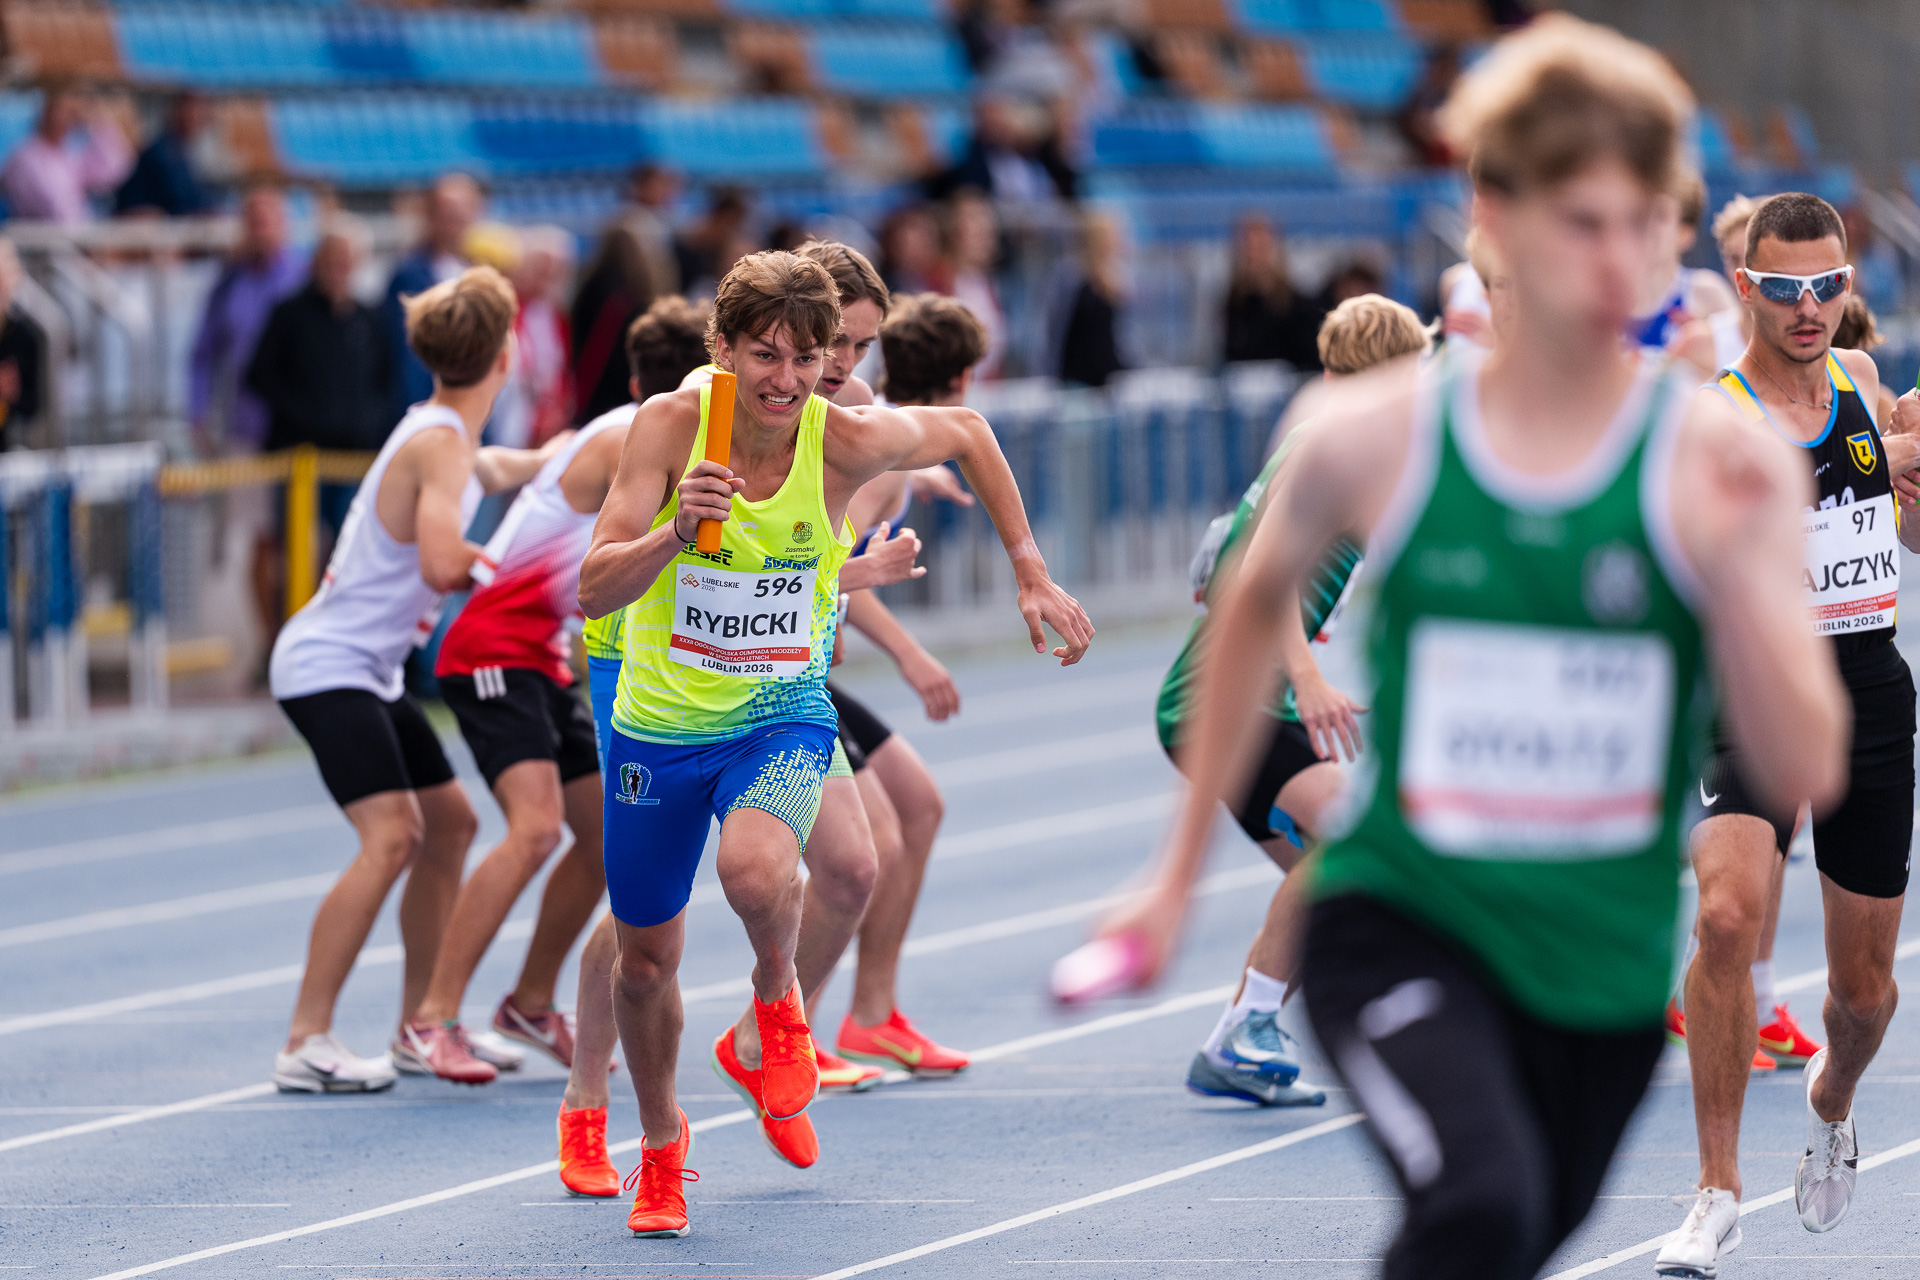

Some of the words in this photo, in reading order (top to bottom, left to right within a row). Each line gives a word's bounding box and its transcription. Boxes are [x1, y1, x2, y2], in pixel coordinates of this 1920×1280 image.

[1852, 506, 1876, 535] 97
[1801, 549, 1897, 592] AJCZYK
[701, 584, 716, 592] 2026
[702, 577, 740, 589] LUBELSKIE
[754, 576, 802, 598] 596
[686, 605, 798, 638] RYBICKI
[1820, 609, 1854, 619] SPORTACH
[1854, 605, 1879, 614] LETNICH
[1813, 620, 1851, 632] UBLIN
[1854, 614, 1884, 627] 2026
[679, 637, 694, 645] XXXII
[694, 640, 738, 657] OGÓLNOPOLSKA
[739, 649, 770, 657] OLIMPIADA
[770, 647, 802, 655] MŁODZIEŻY
[701, 658, 741, 673] LUBLIN
[744, 664, 773, 673] 2026
[715, 653, 746, 662] SPORTACH
